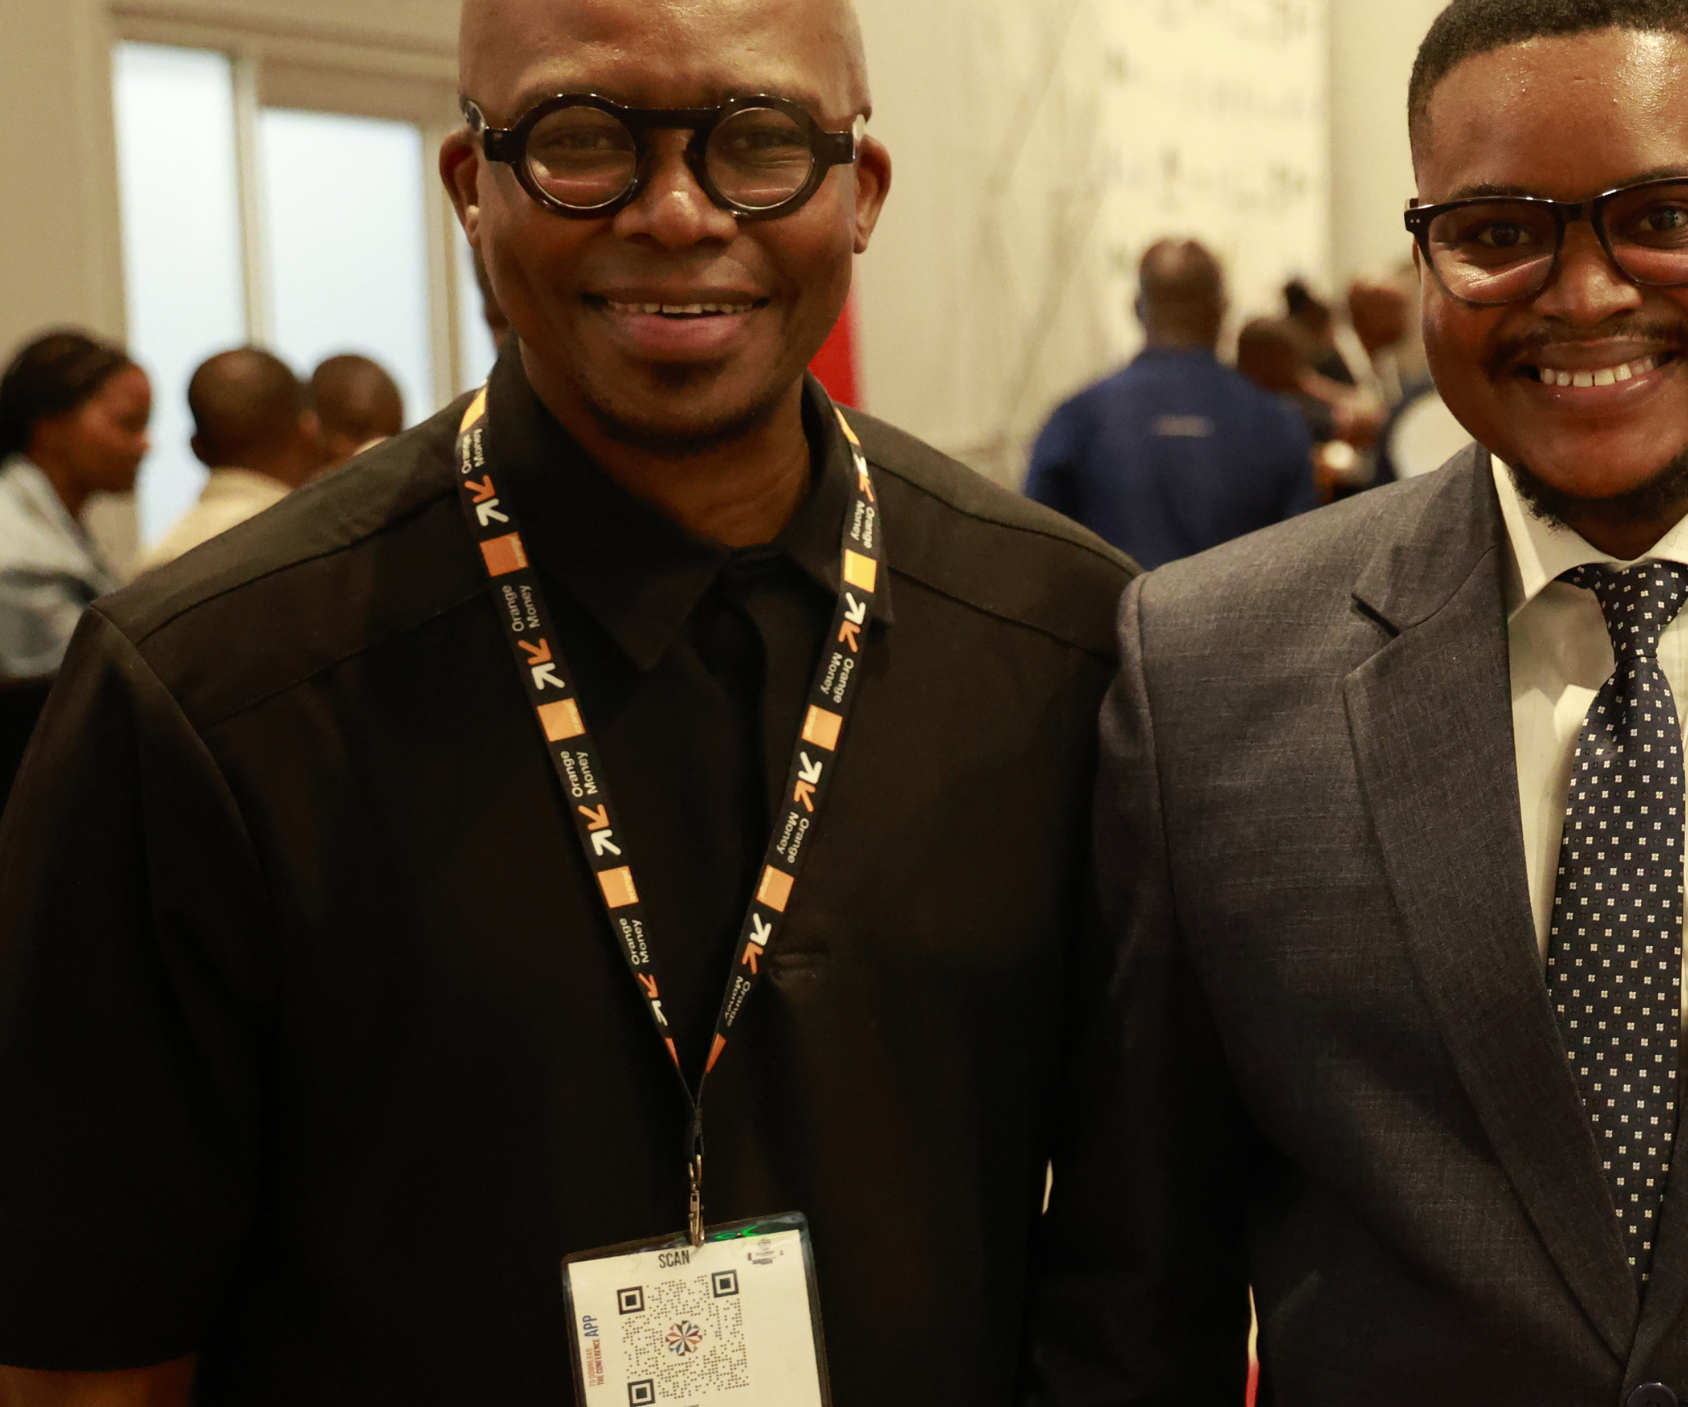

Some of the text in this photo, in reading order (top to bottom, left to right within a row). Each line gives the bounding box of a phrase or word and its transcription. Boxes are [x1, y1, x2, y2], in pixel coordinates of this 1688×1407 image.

[850, 500, 865, 541] Money
[863, 505, 875, 549] Orange
[502, 584, 525, 632] Orange
[520, 584, 541, 629] Money
[820, 651, 843, 695] Money
[833, 657, 855, 704] Orange
[560, 751, 583, 798] Orange
[576, 751, 598, 795] Money
[776, 811, 799, 855] Money
[787, 817, 810, 864] Orange
[619, 917, 640, 966] Orange
[632, 919, 650, 964] Money
[658, 1249, 690, 1269] SCAN
[582, 1315, 599, 1337] APP
